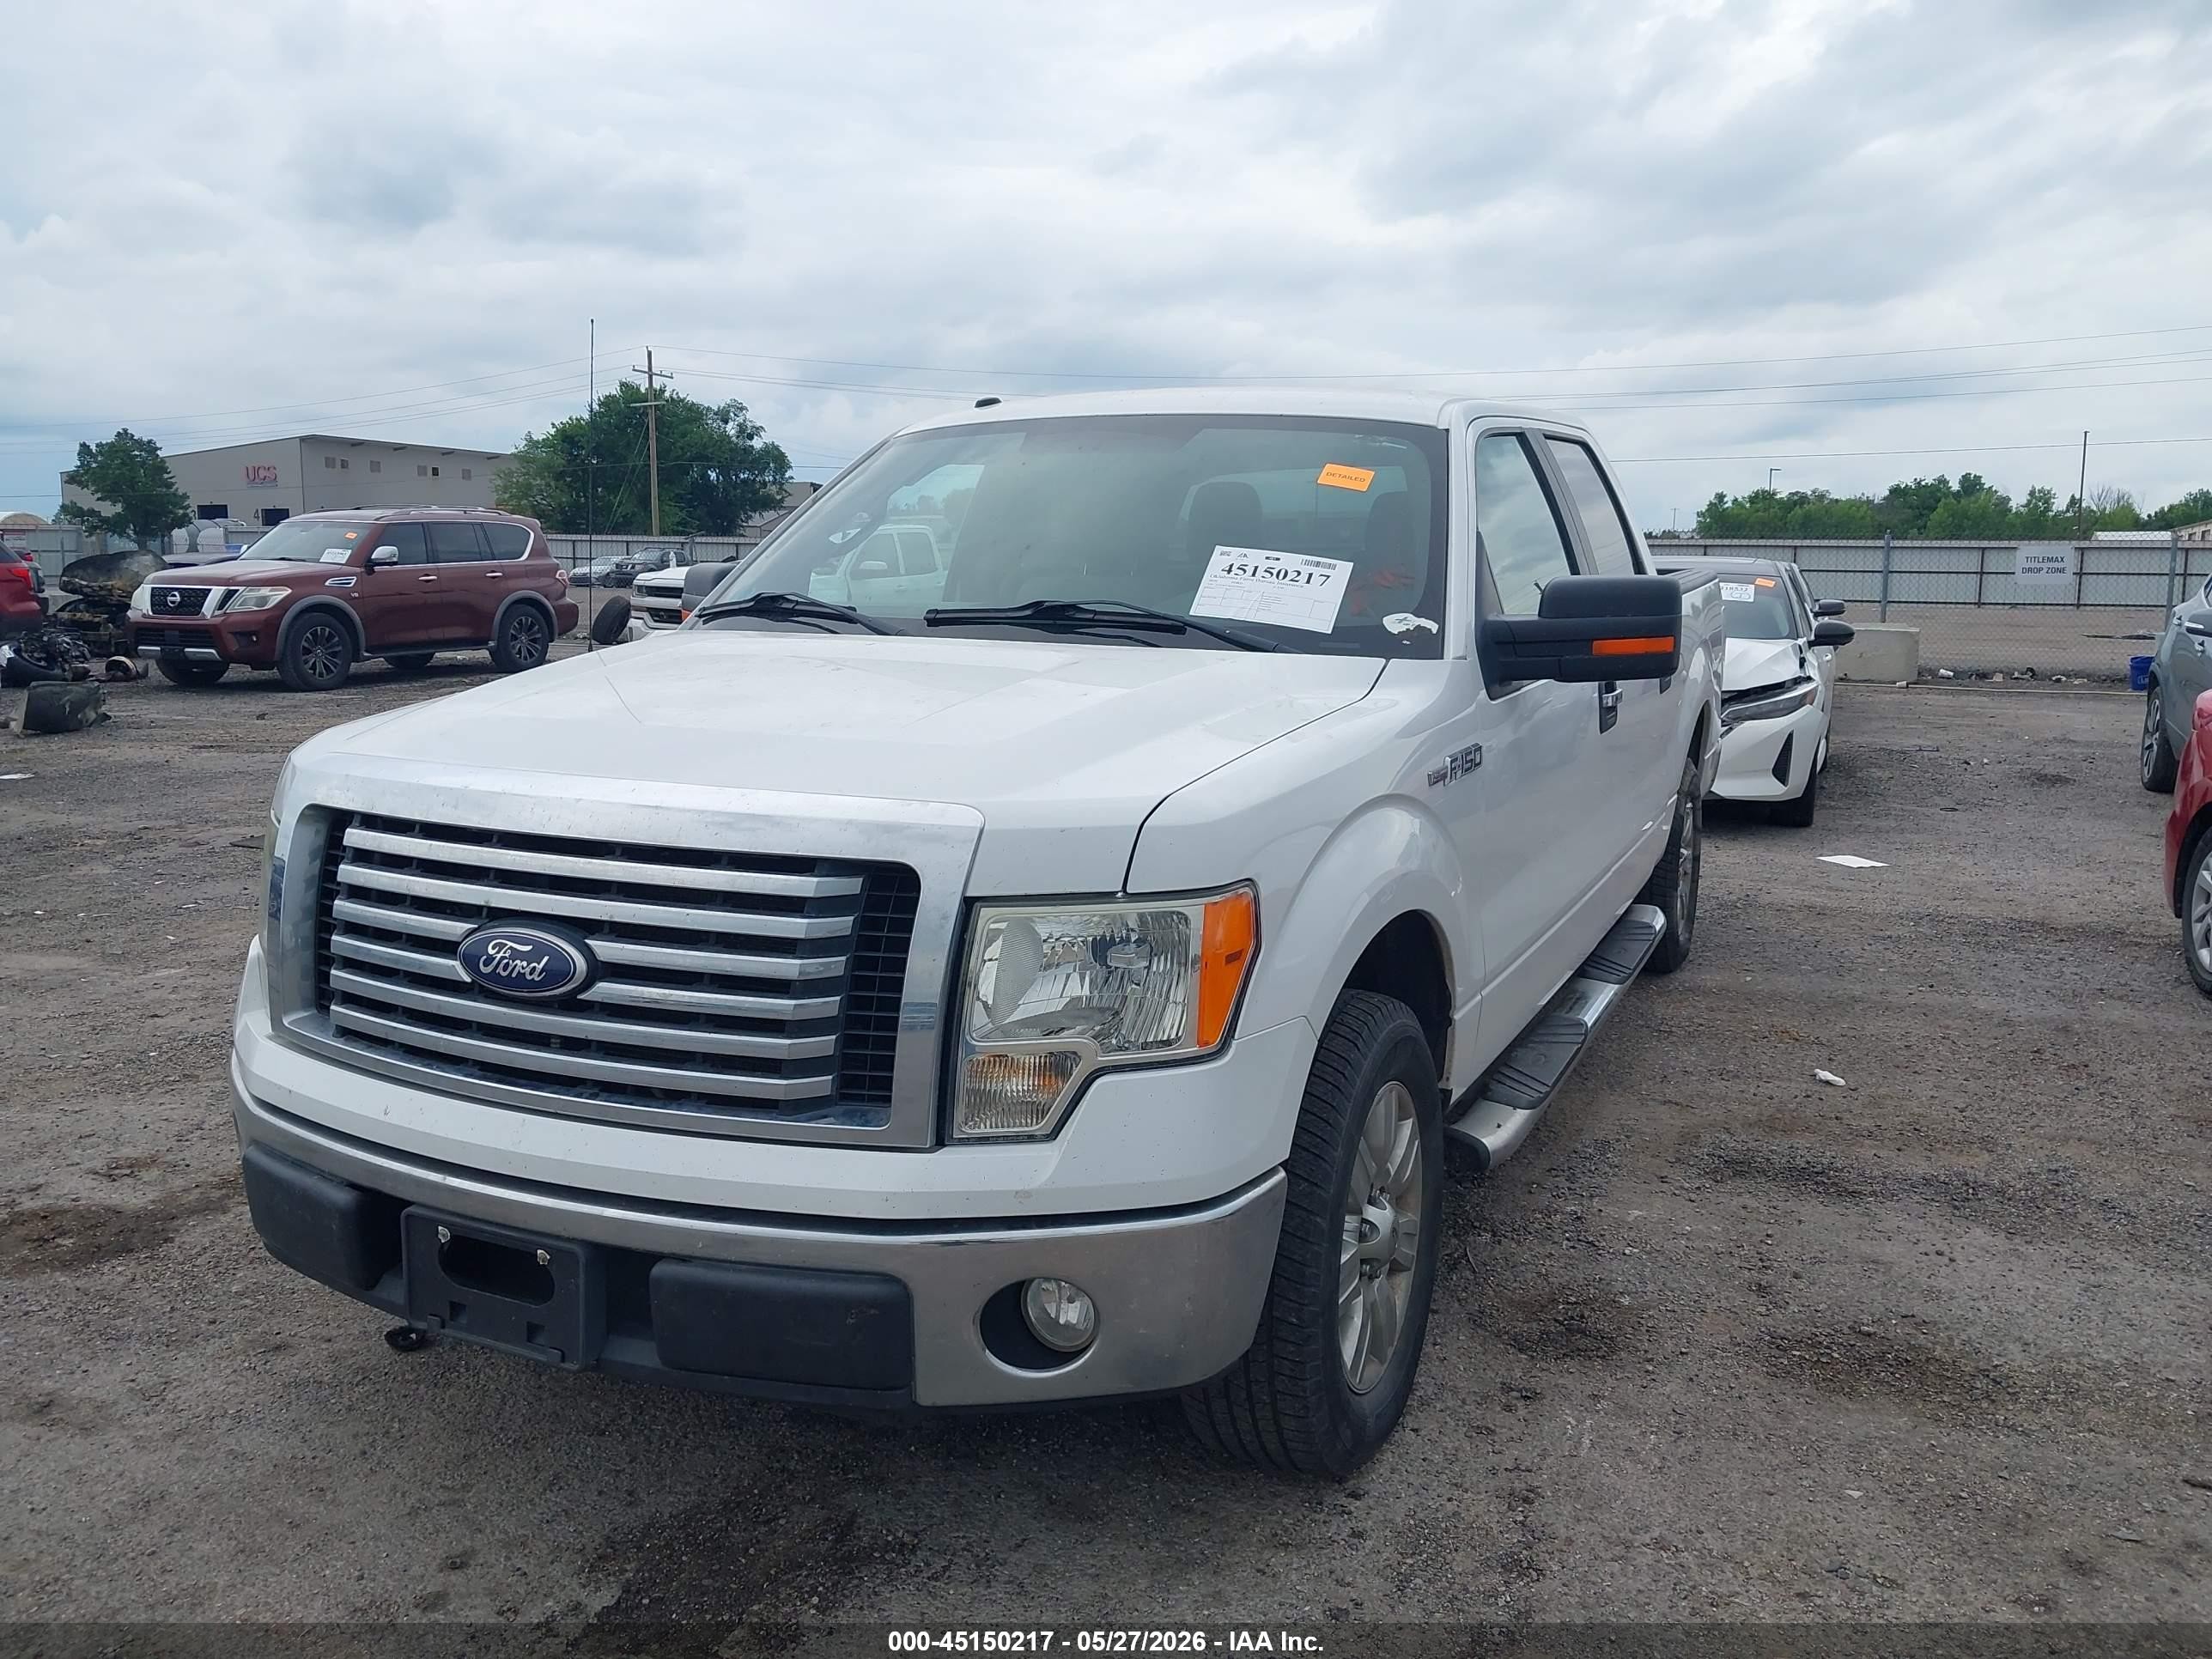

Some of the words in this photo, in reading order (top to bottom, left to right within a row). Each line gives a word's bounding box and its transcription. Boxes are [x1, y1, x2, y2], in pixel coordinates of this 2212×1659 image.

[246, 465, 277, 482] UCS
[253, 508, 260, 521] 4
[2025, 556, 2066, 564] TITLEMAX
[1220, 562, 1333, 587] 45150217
[478, 939, 550, 981] Ford
